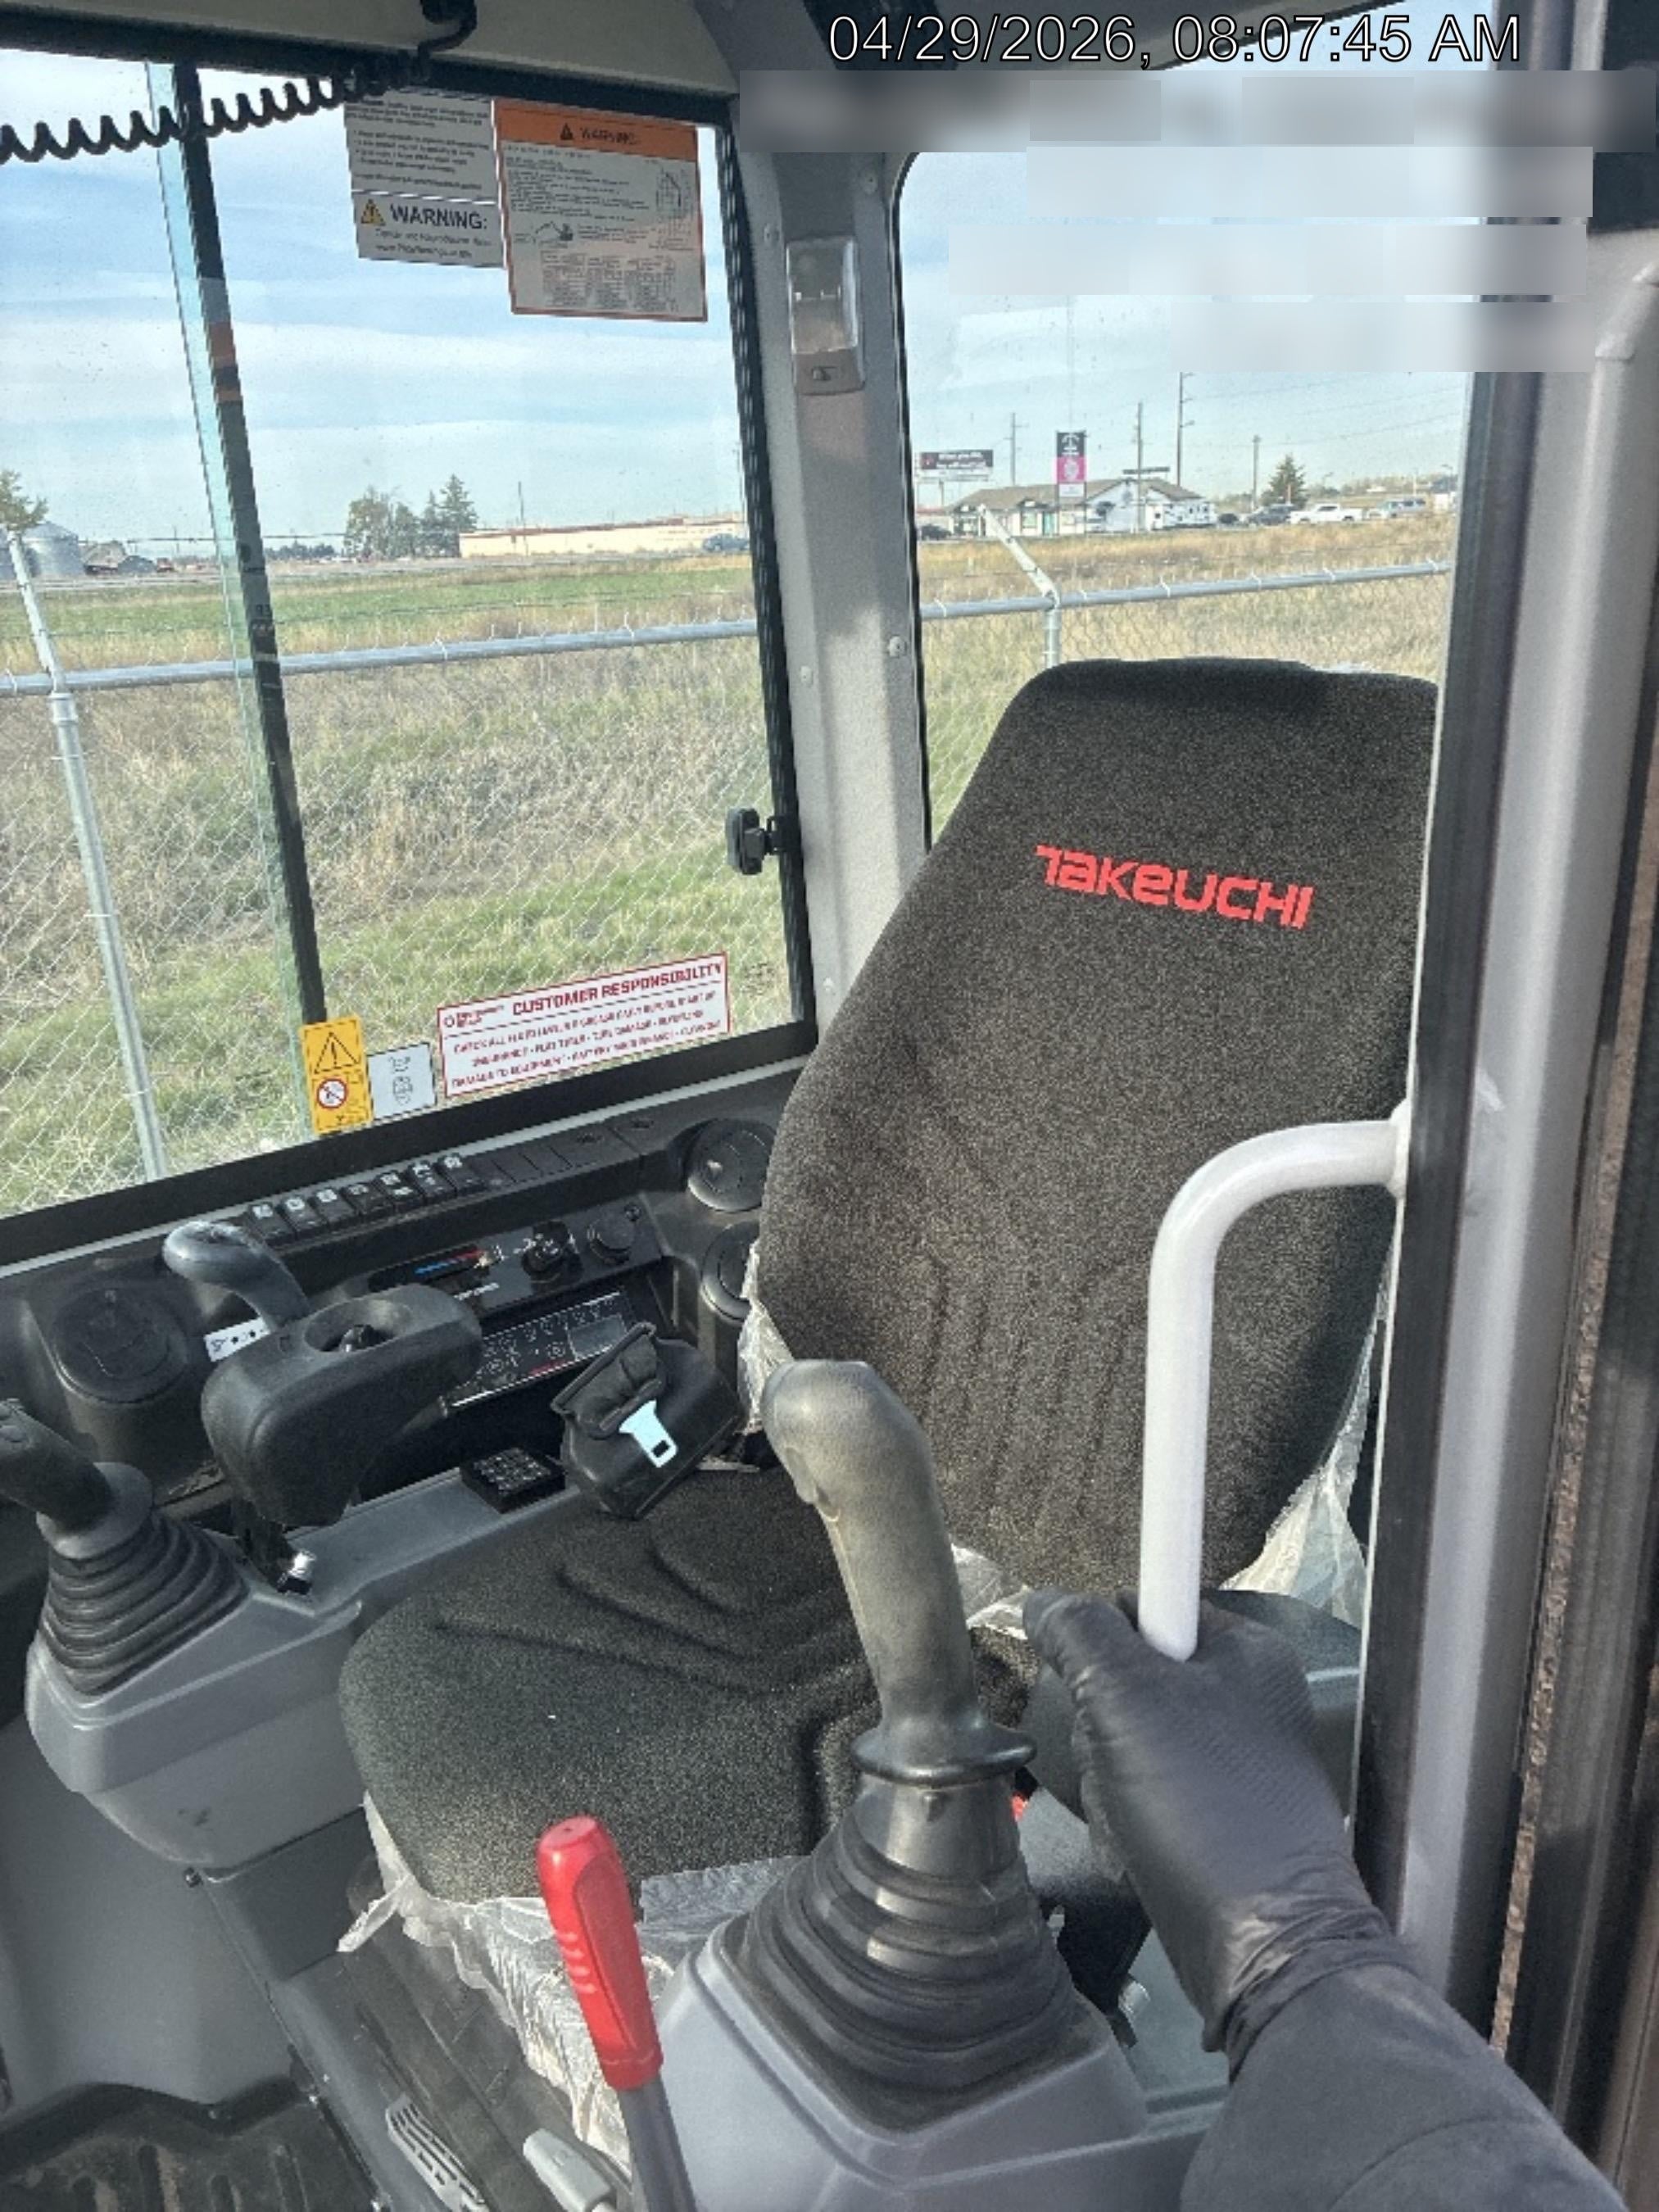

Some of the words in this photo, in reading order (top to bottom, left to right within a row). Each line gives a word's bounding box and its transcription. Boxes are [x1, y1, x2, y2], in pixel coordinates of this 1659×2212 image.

[390, 203, 487, 230] WARNING:
[513, 987, 598, 1016] CUSTOMER
[601, 963, 722, 999] RESPONSIBILITY
